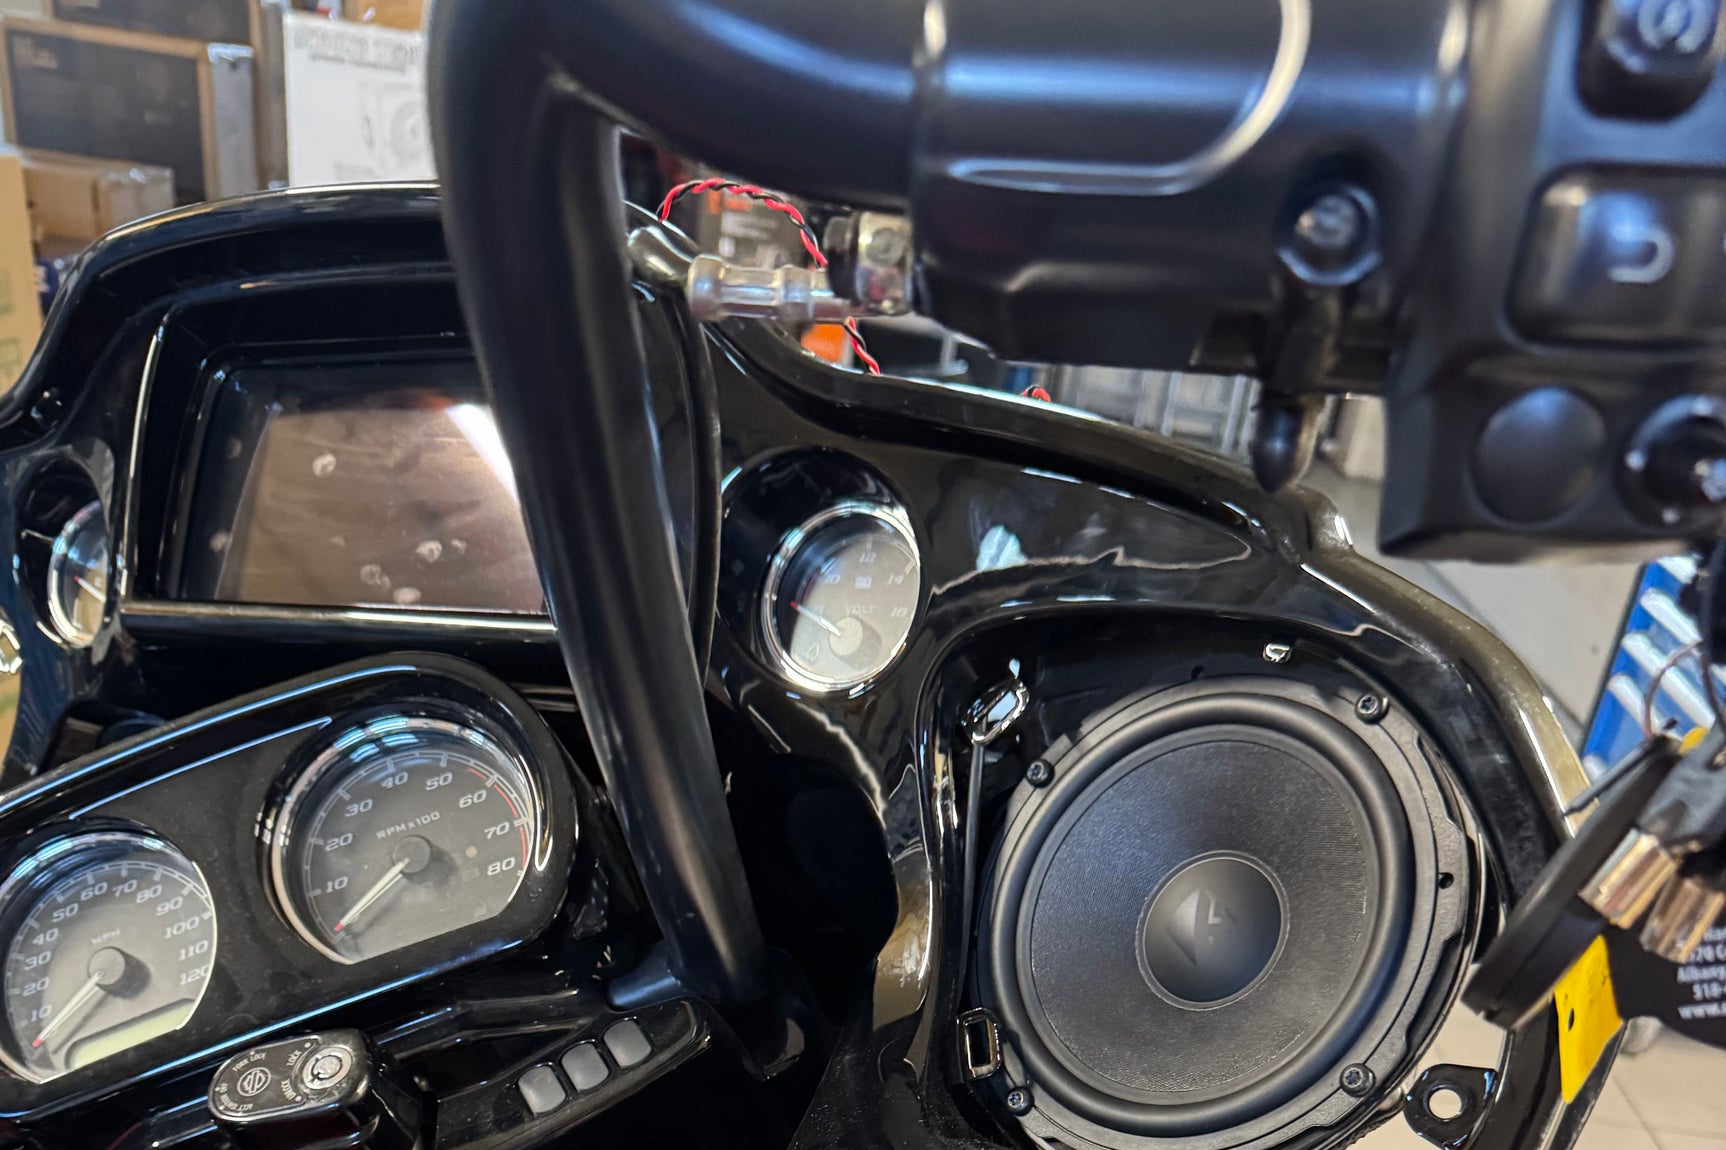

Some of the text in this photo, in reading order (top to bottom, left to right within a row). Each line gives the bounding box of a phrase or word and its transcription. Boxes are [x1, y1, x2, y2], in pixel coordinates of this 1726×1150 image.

[859, 552, 877, 563] 12
[887, 574, 905, 585] 14
[381, 772, 409, 790] 40
[425, 773, 453, 791] 50
[345, 798, 373, 818] 30
[458, 789, 487, 809] 60
[484, 821, 510, 840] 70
[325, 833, 353, 852] 20
[486, 857, 516, 877] 80
[80, 882, 108, 902] 60
[112, 879, 138, 897] 70
[135, 885, 162, 903] 80
[326, 876, 348, 893] 10
[52, 903, 80, 923] 50
[155, 897, 184, 916] 90
[31, 928, 59, 946] 40
[90, 928, 121, 945] MPH
[163, 916, 200, 940] 100
[178, 940, 209, 961] 110
[23, 951, 51, 971] 30
[179, 965, 209, 986] 120
[22, 976, 50, 997] 20
[30, 1005, 51, 1022] 10
[250, 1052, 267, 1062] LOCK
[286, 1050, 302, 1066] LOCK
